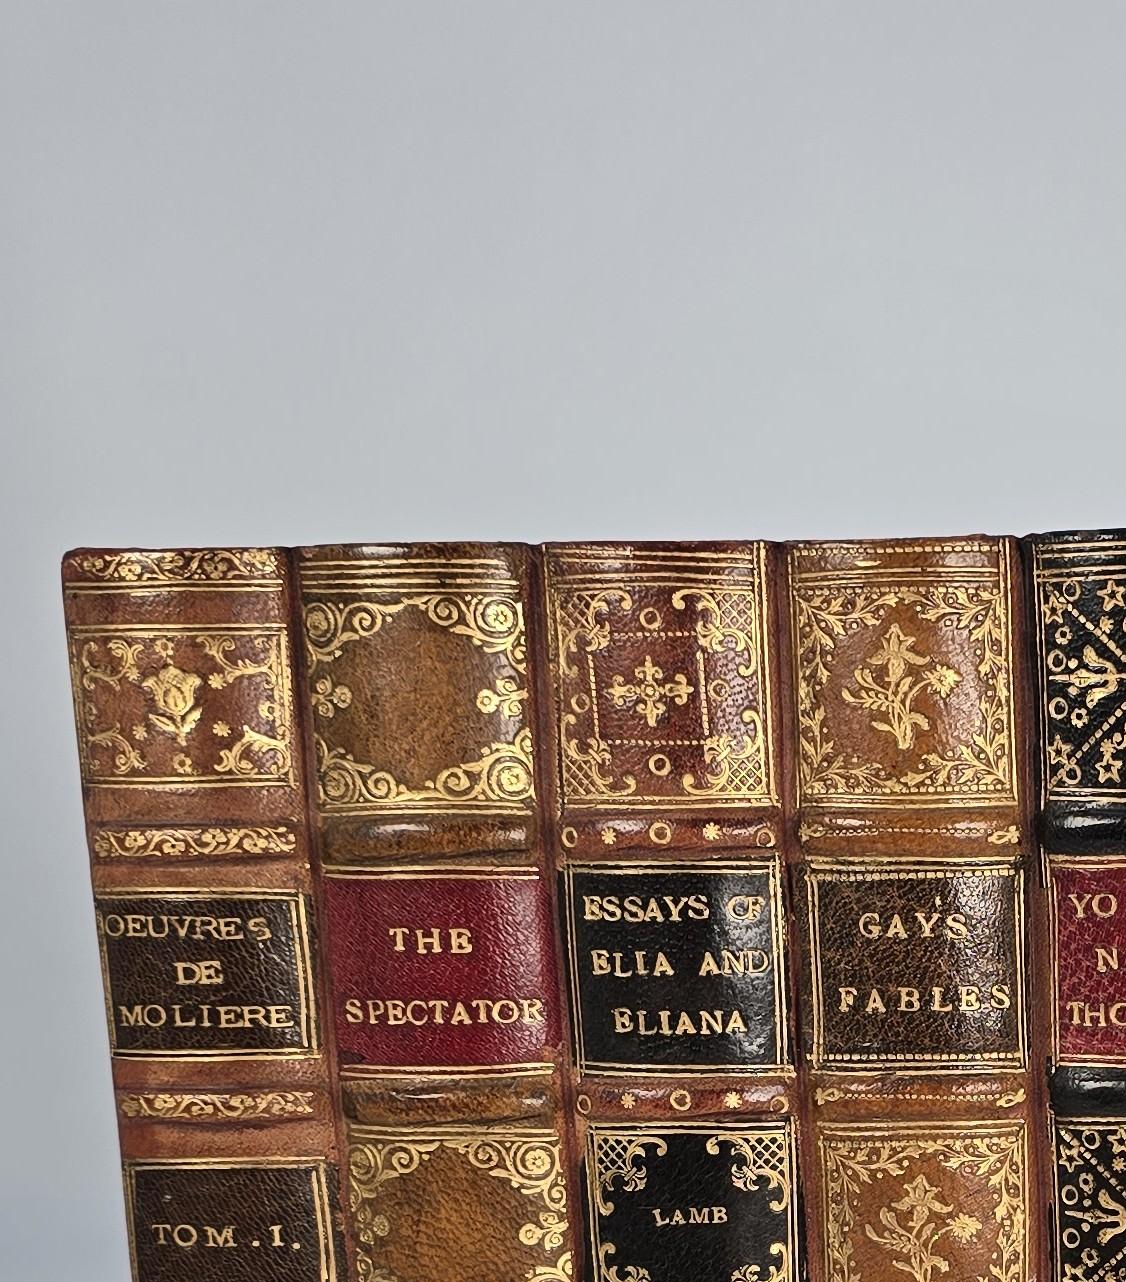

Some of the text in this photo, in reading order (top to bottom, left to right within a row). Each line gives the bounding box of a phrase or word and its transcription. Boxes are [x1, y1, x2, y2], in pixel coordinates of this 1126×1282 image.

[583, 895, 765, 922] ESSAYS OF
[105, 914, 272, 940] OEUVRES
[389, 928, 473, 954] THE
[175, 960, 224, 985] DE
[591, 949, 769, 977] ELIA AND
[344, 999, 546, 1025] SPECTATOR
[839, 985, 1011, 1013] FABLES
[120, 1004, 294, 1028] MOLIERE
[613, 1008, 748, 1035] ELIANA
[653, 1208, 728, 1226] LAMB
